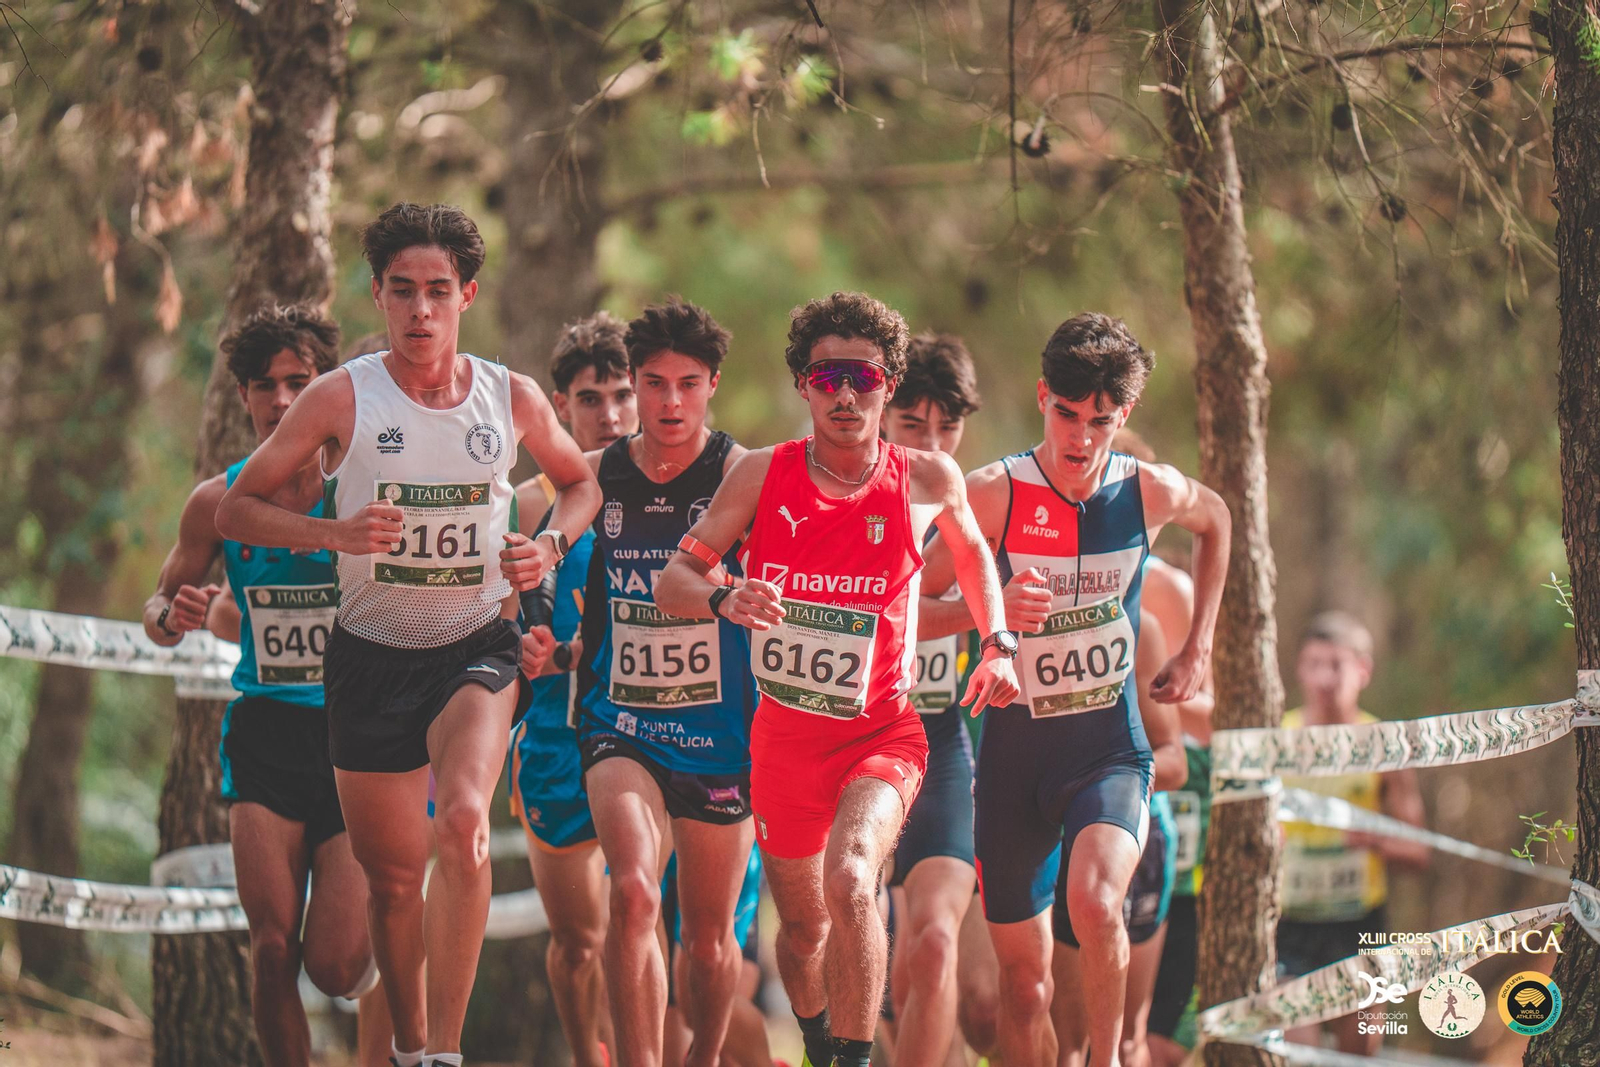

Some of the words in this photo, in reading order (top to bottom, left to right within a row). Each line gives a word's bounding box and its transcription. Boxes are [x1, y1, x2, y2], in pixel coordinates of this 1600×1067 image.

[409, 486, 464, 501] ITÁLICA
[644, 505, 675, 513] amura
[1022, 523, 1060, 540] VIATOR
[613, 549, 640, 559] CLUB
[792, 572, 888, 595] navarra
[636, 606, 680, 621] ITÁLI
[788, 605, 845, 626] ITÁLICA
[1050, 607, 1105, 629] ITÁLICA
[620, 641, 711, 678] 6156
[762, 637, 861, 689] 6162
[1035, 636, 1130, 686] 6402
[641, 720, 686, 734] XUNTA
